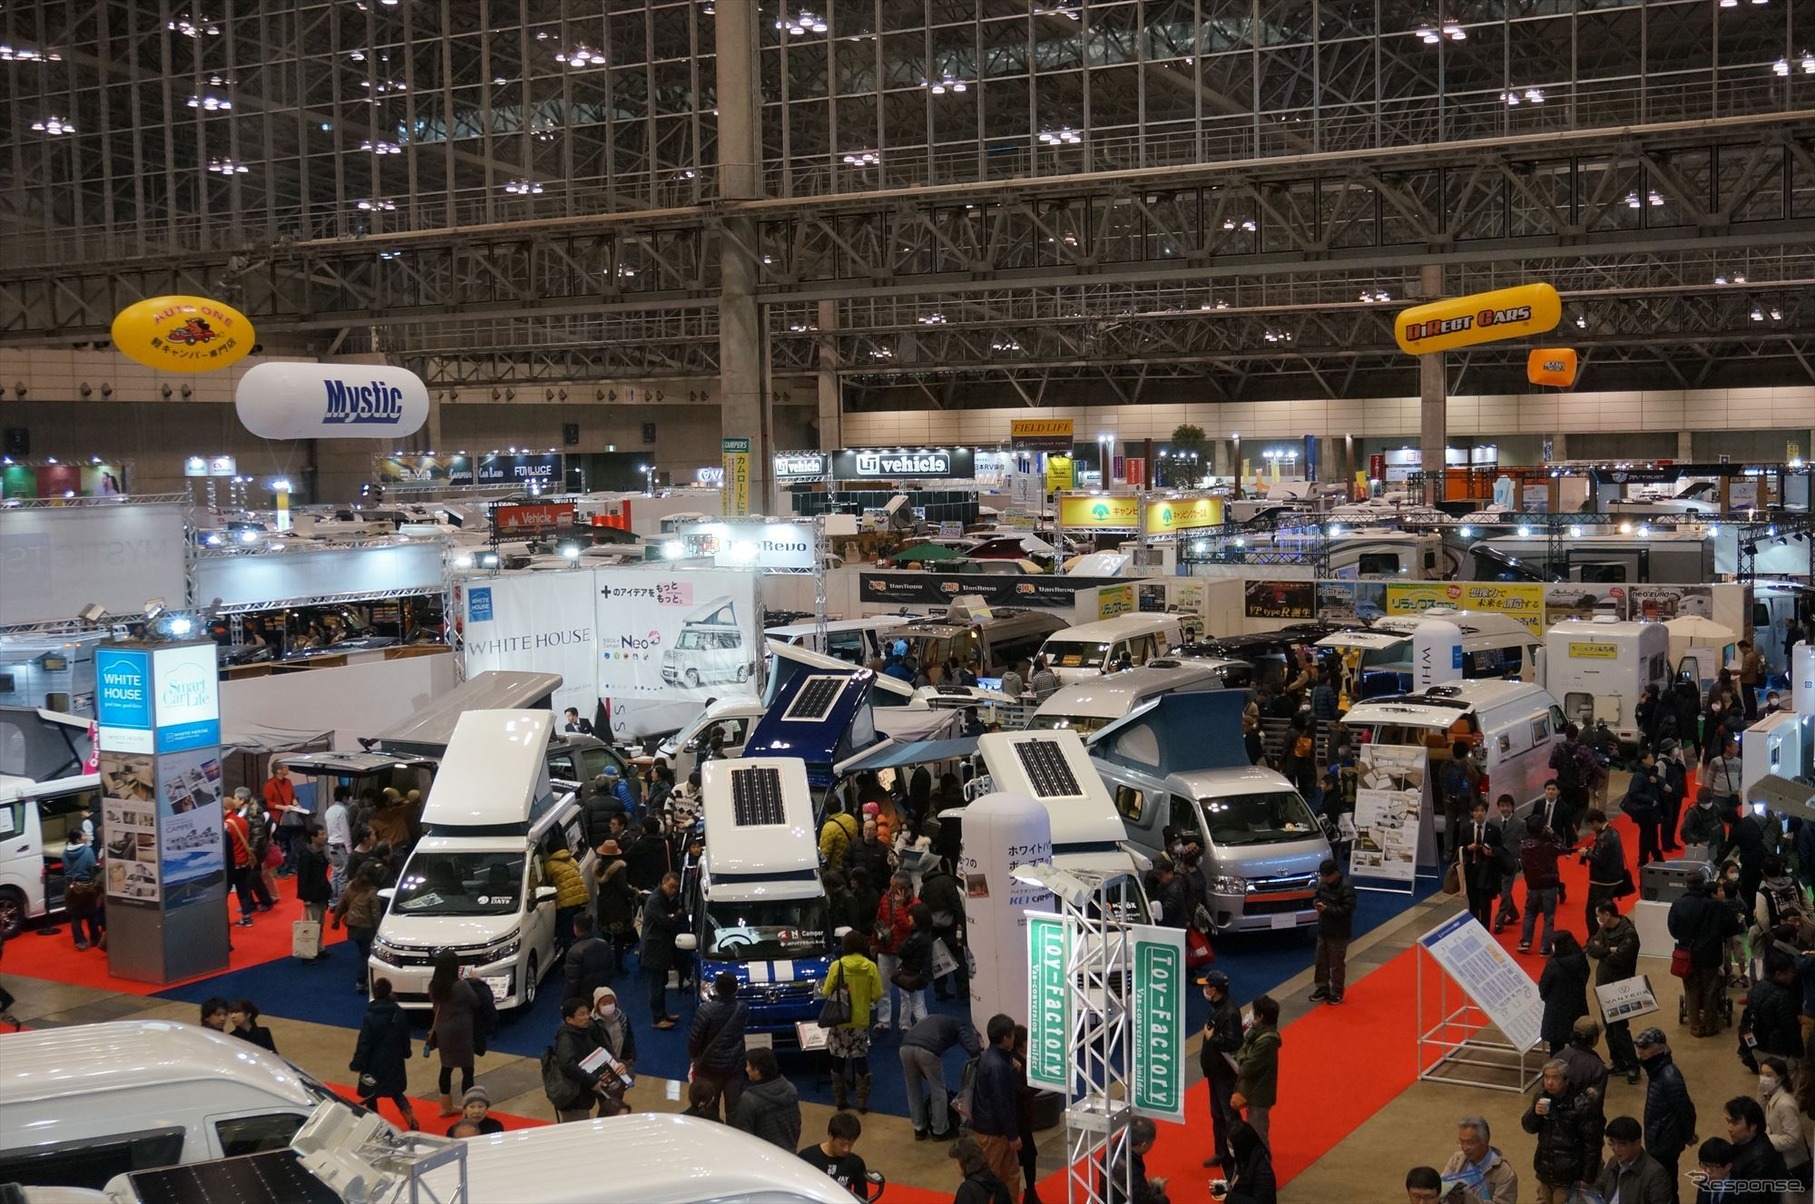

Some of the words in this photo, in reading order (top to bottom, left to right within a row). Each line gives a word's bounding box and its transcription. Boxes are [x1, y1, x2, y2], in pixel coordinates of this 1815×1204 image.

[153, 306, 197, 324] AUTO
[201, 306, 233, 327] ONE
[324, 380, 402, 423] Mystic
[1014, 423, 1045, 432] FIELD
[1046, 423, 1069, 432] LIFE
[724, 441, 747, 449] CAMPERS
[656, 581, 678, 593] もっと
[1263, 608, 1280, 617] type
[1280, 606, 1290, 617] R
[468, 635, 532, 656] WHITE
[536, 627, 590, 648] HOUSE
[621, 634, 649, 649] Neo
[103, 673, 142, 686] WHITE
[104, 687, 143, 700] HOUSE
[1031, 964, 1039, 1033] Van-conversion
[1043, 933, 1064, 1076] Toy-Factory
[1136, 988, 1144, 1058] Van-conversion
[1149, 956, 1173, 1103] Toy-Factory
[1031, 1038, 1039, 1070] builder
[1136, 1065, 1144, 1097] builder
